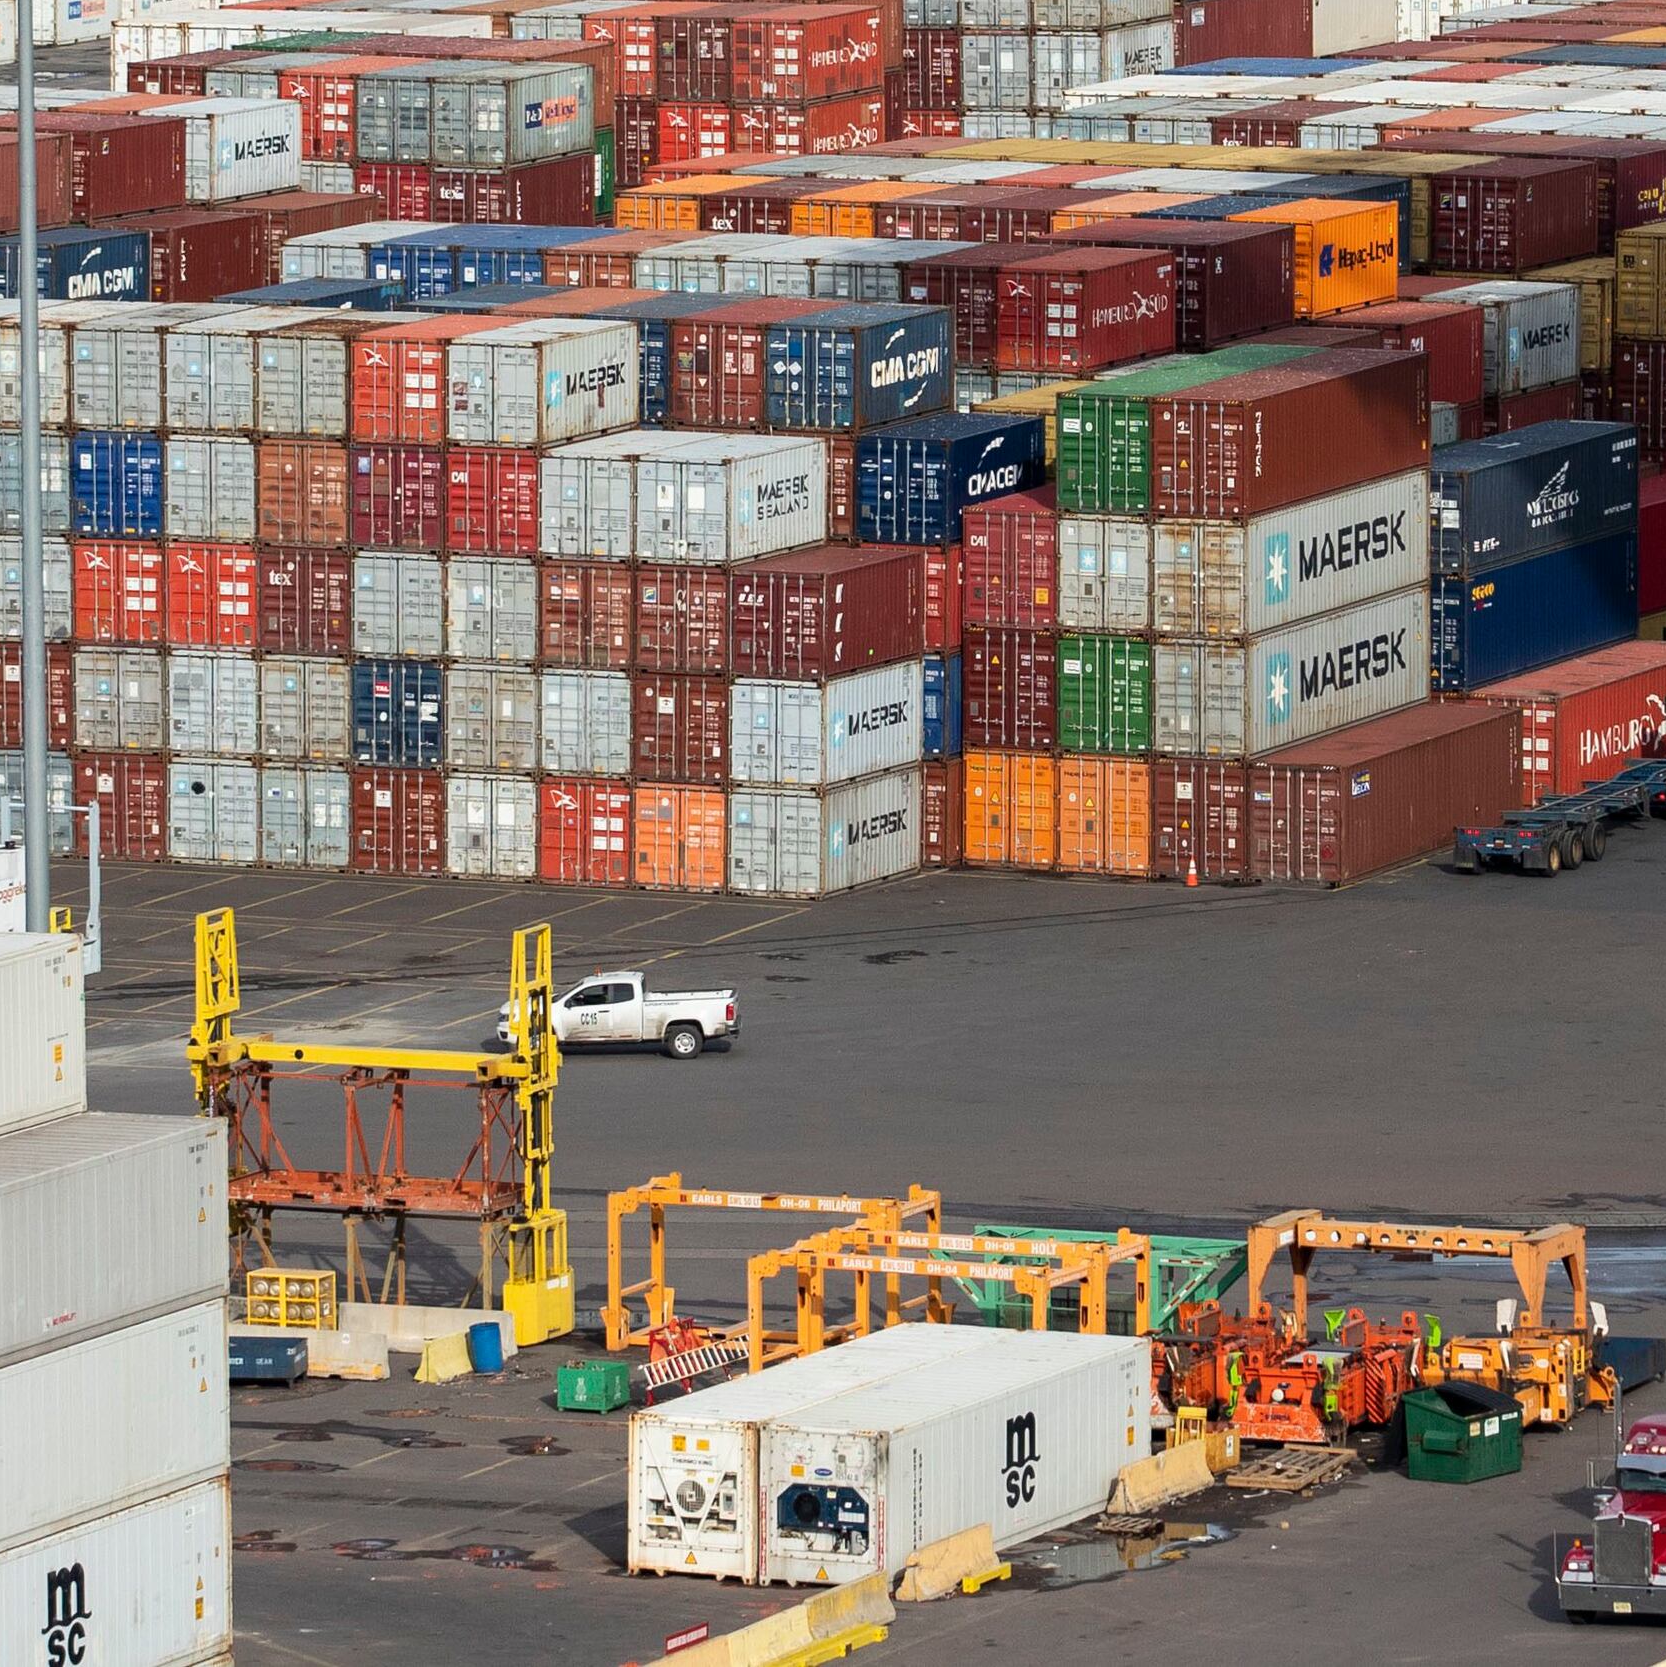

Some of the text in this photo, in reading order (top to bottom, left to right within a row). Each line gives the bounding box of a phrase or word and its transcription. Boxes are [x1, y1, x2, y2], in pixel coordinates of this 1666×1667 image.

[235, 135, 290, 160] MAERSK
[712, 216, 733, 229] tex
[1338, 239, 1394, 270] Hapag-Lloyd
[68, 266, 133, 300] CMA CGM
[1523, 322, 1569, 350] MAERSK
[566, 362, 626, 396] MAERSK
[871, 355, 905, 389] CMA
[452, 472, 468, 483] CAI
[757, 475, 809, 503] MAERSK
[757, 497, 809, 520] SEALAND
[971, 535, 987, 546] CAI
[1298, 510, 1405, 582] MAERSK
[269, 570, 292, 586] tex
[1299, 628, 1406, 702] MAERSK
[848, 700, 908, 739] MAERSK
[1580, 717, 1652, 765] HAMBURG
[848, 809, 908, 847] MAERSK
[580, 1013, 597, 1025] CC15
[691, 1196, 723, 1204] EARLS
[818, 1200, 862, 1212] PHILAPORT
[897, 1236, 930, 1247] EARLS
[1031, 1244, 1058, 1254] HOLT
[842, 1258, 874, 1269] EARLS
[969, 1265, 1014, 1278] PHILAPORT
